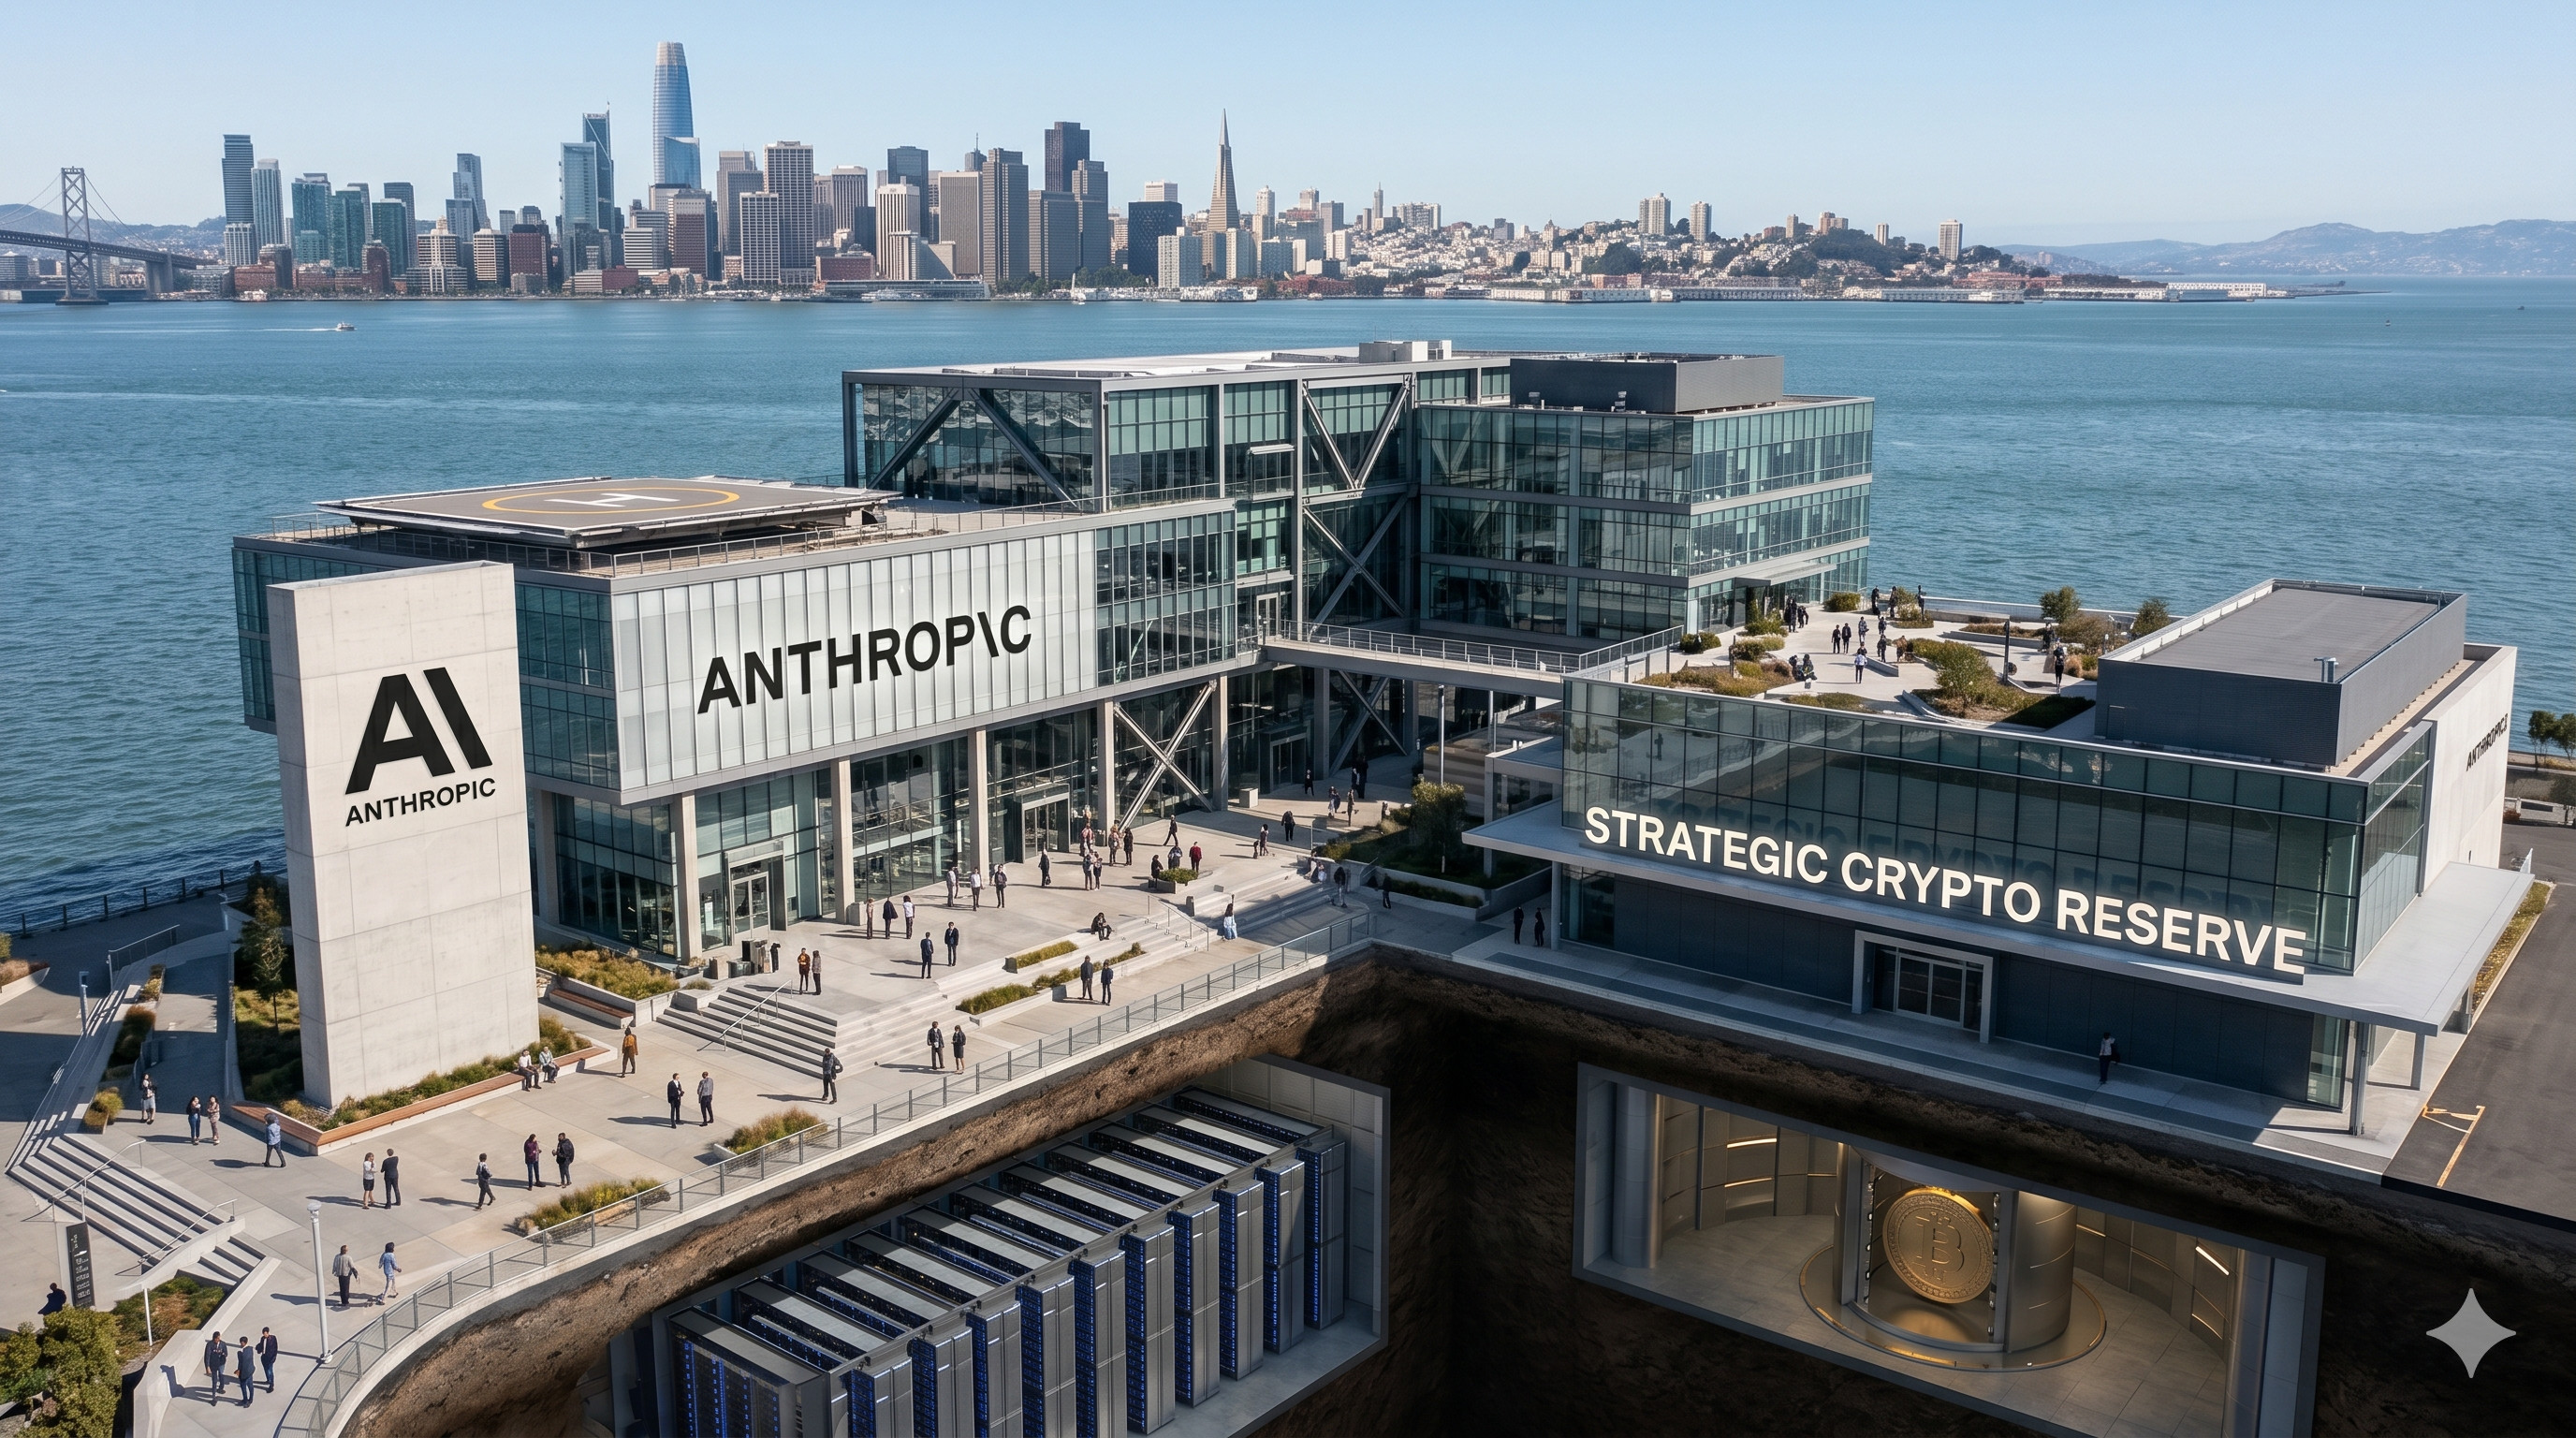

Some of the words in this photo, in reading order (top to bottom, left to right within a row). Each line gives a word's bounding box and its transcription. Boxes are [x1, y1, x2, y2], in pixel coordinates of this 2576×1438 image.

[345, 777, 496, 828] ANTHROPIC
[1585, 806, 1829, 884] STRATEGIC
[1840, 851, 2042, 924] CRYPTO
[2056, 888, 2307, 976] RESERVE
